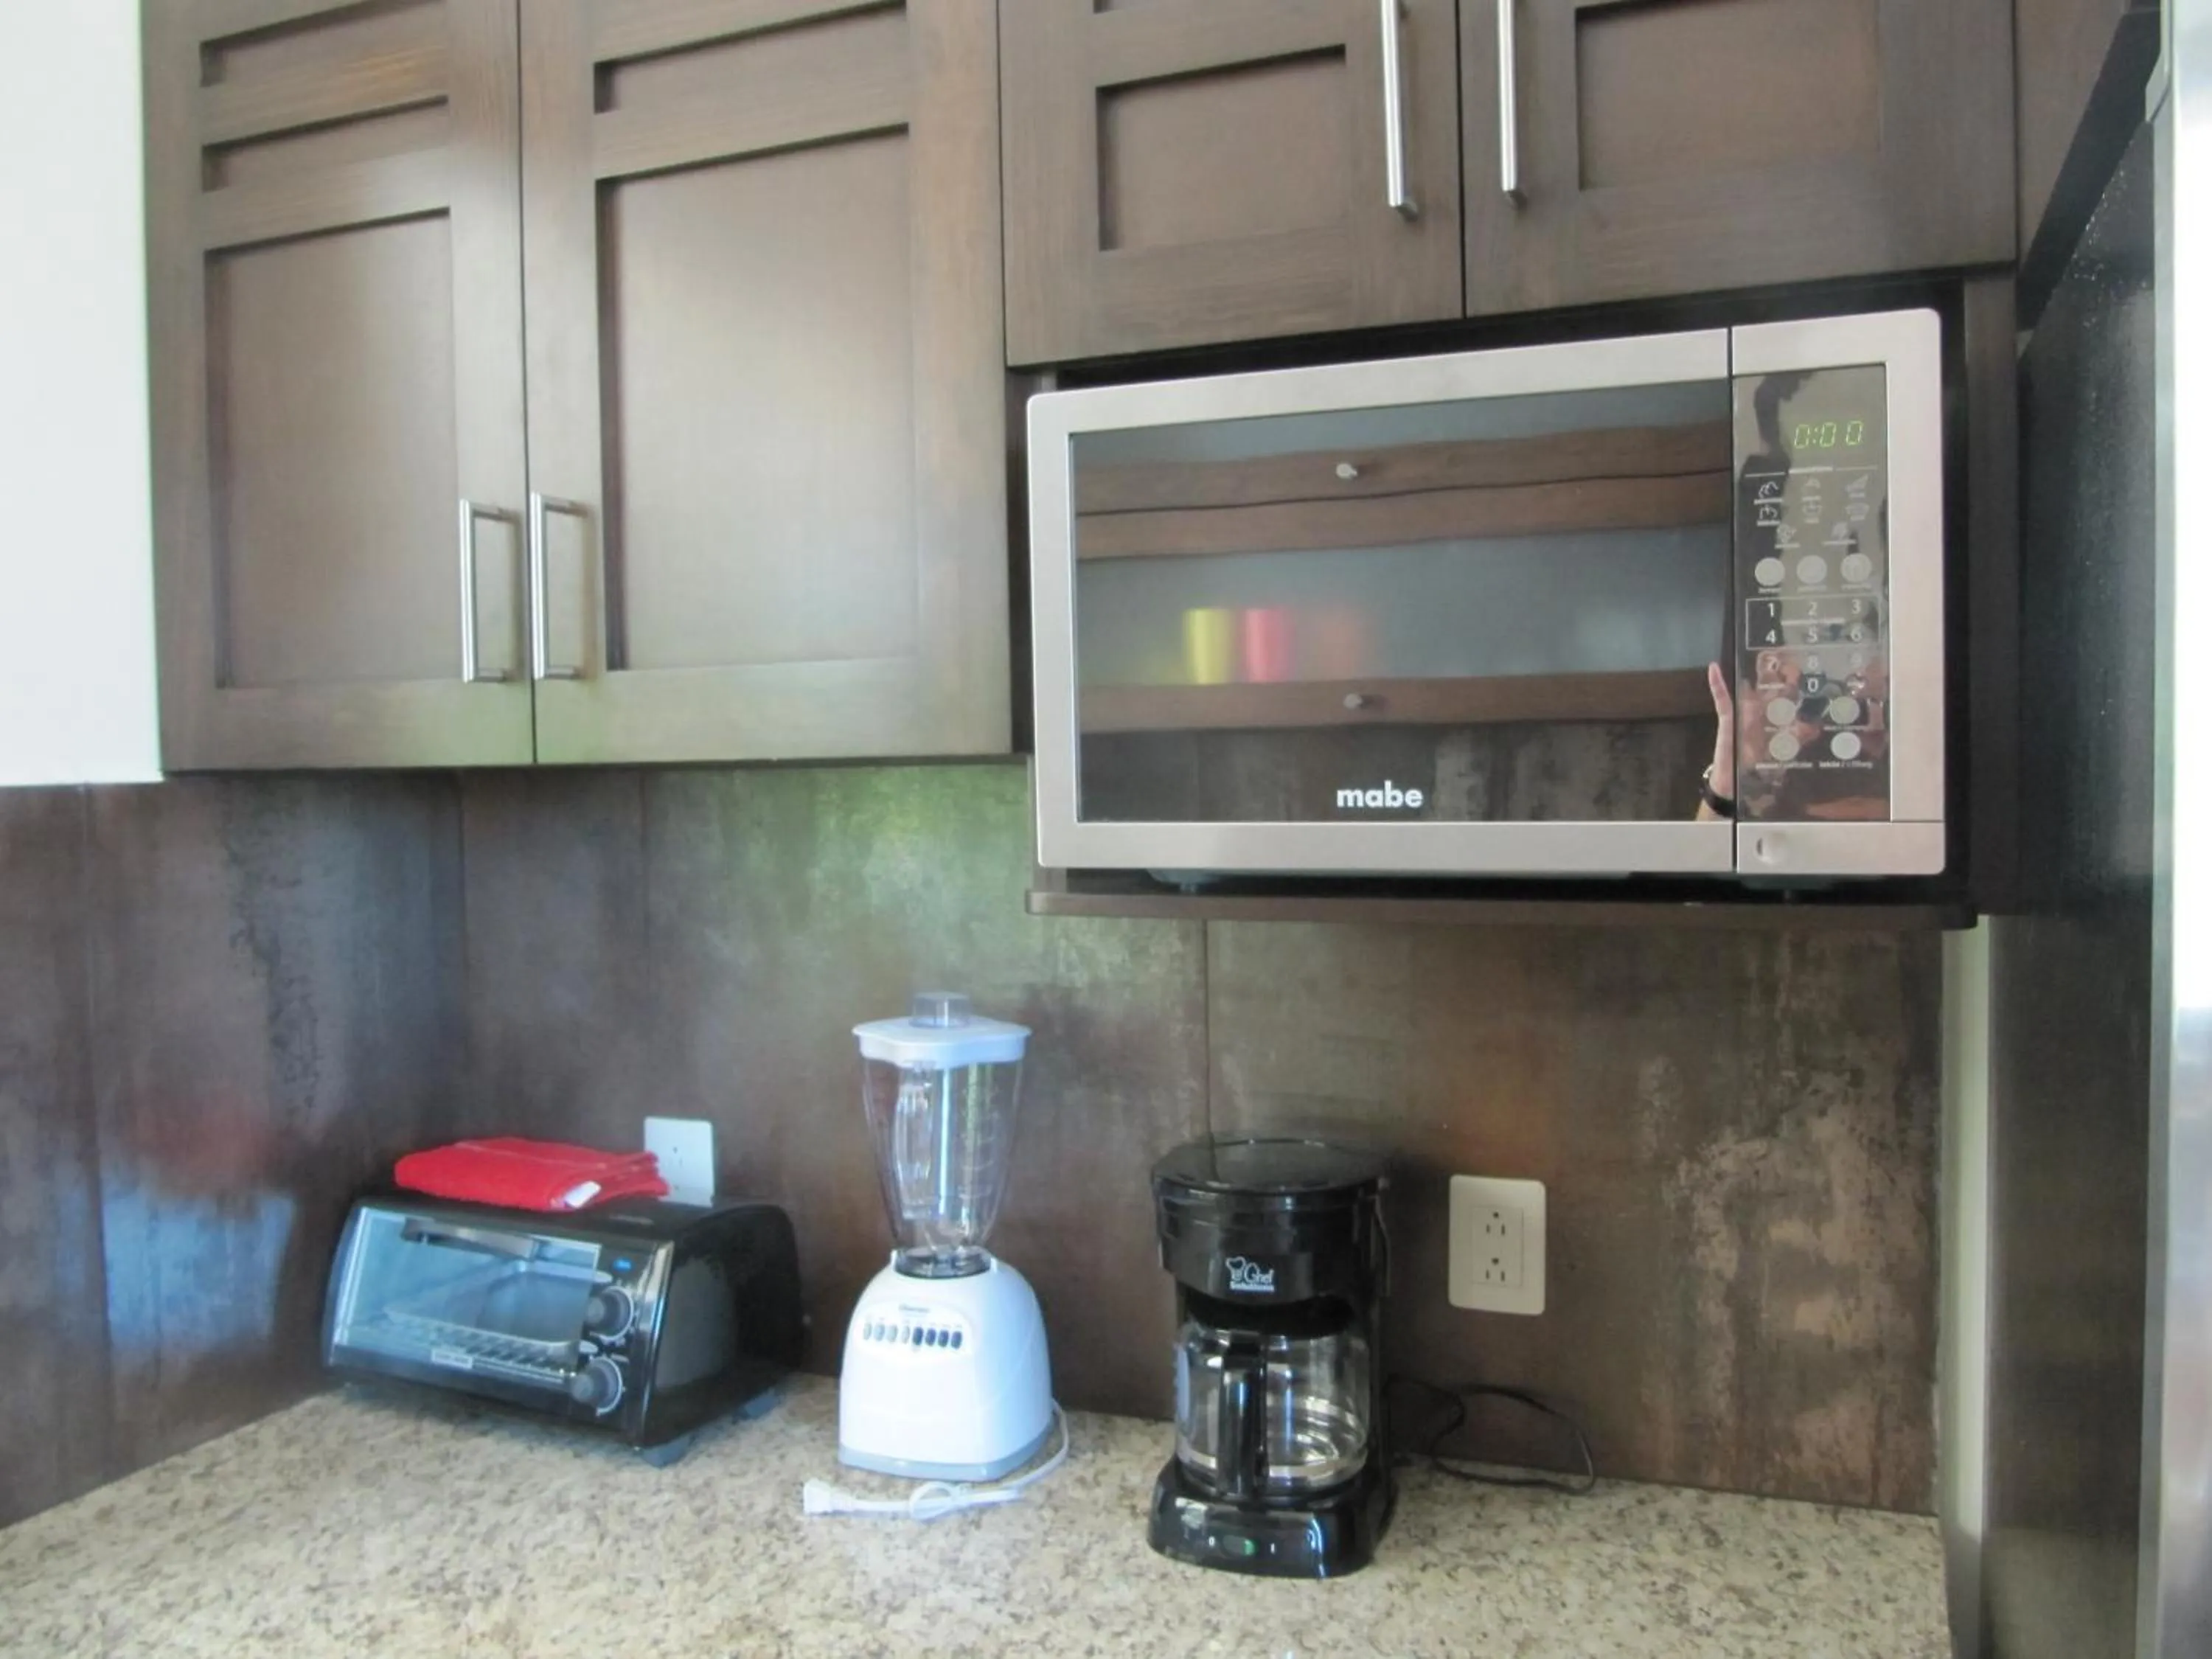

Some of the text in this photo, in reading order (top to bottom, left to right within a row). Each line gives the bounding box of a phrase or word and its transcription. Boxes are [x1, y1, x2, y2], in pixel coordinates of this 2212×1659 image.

[1794, 420, 1864, 448] 0:00
[1767, 599, 1862, 617] 1 2 3
[1765, 627, 1863, 644] 4 5 6
[1807, 678, 1819, 692] 0
[1337, 779, 1423, 808] mabe
